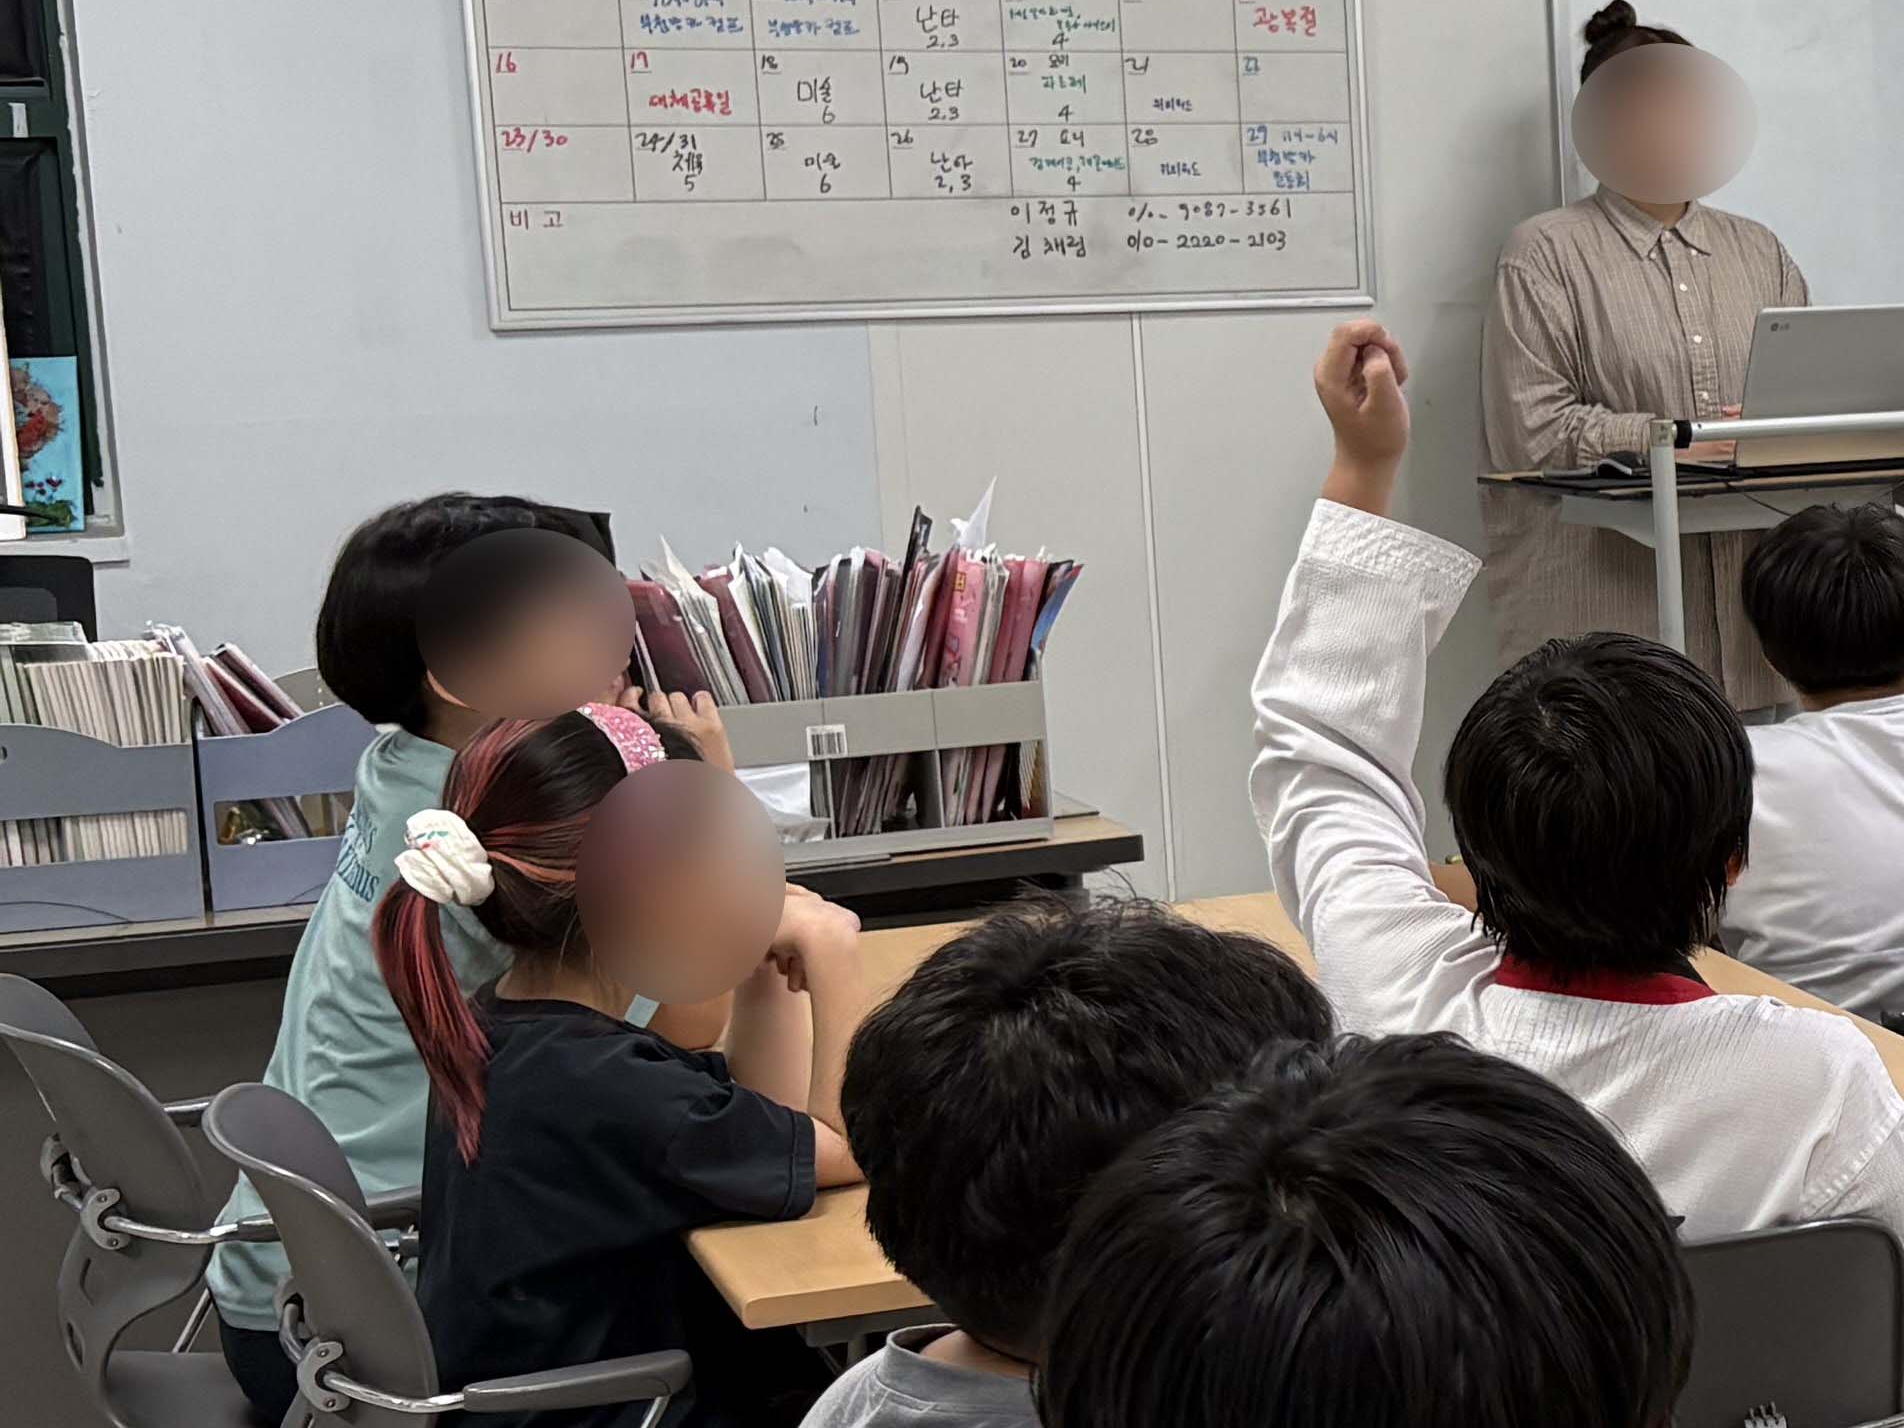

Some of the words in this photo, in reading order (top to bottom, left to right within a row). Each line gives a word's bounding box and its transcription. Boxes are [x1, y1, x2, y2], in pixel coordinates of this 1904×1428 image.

[917, 5, 960, 33] 난타
[1253, 6, 1316, 36] 광복절
[1052, 32, 1069, 51] 4
[496, 51, 517, 72] 16
[762, 55, 778, 70] 18
[1010, 57, 1027, 68] 20
[797, 76, 832, 103] 미술
[920, 79, 964, 103] 난타
[822, 106, 835, 124] 6
[1058, 104, 1074, 122] 4
[502, 128, 568, 153] 23/30
[636, 132, 697, 153] 24/31
[1018, 130, 1038, 144] 27
[1247, 126, 1268, 144] 29
[821, 174, 832, 193] 6
[1067, 176, 1081, 191] 4
